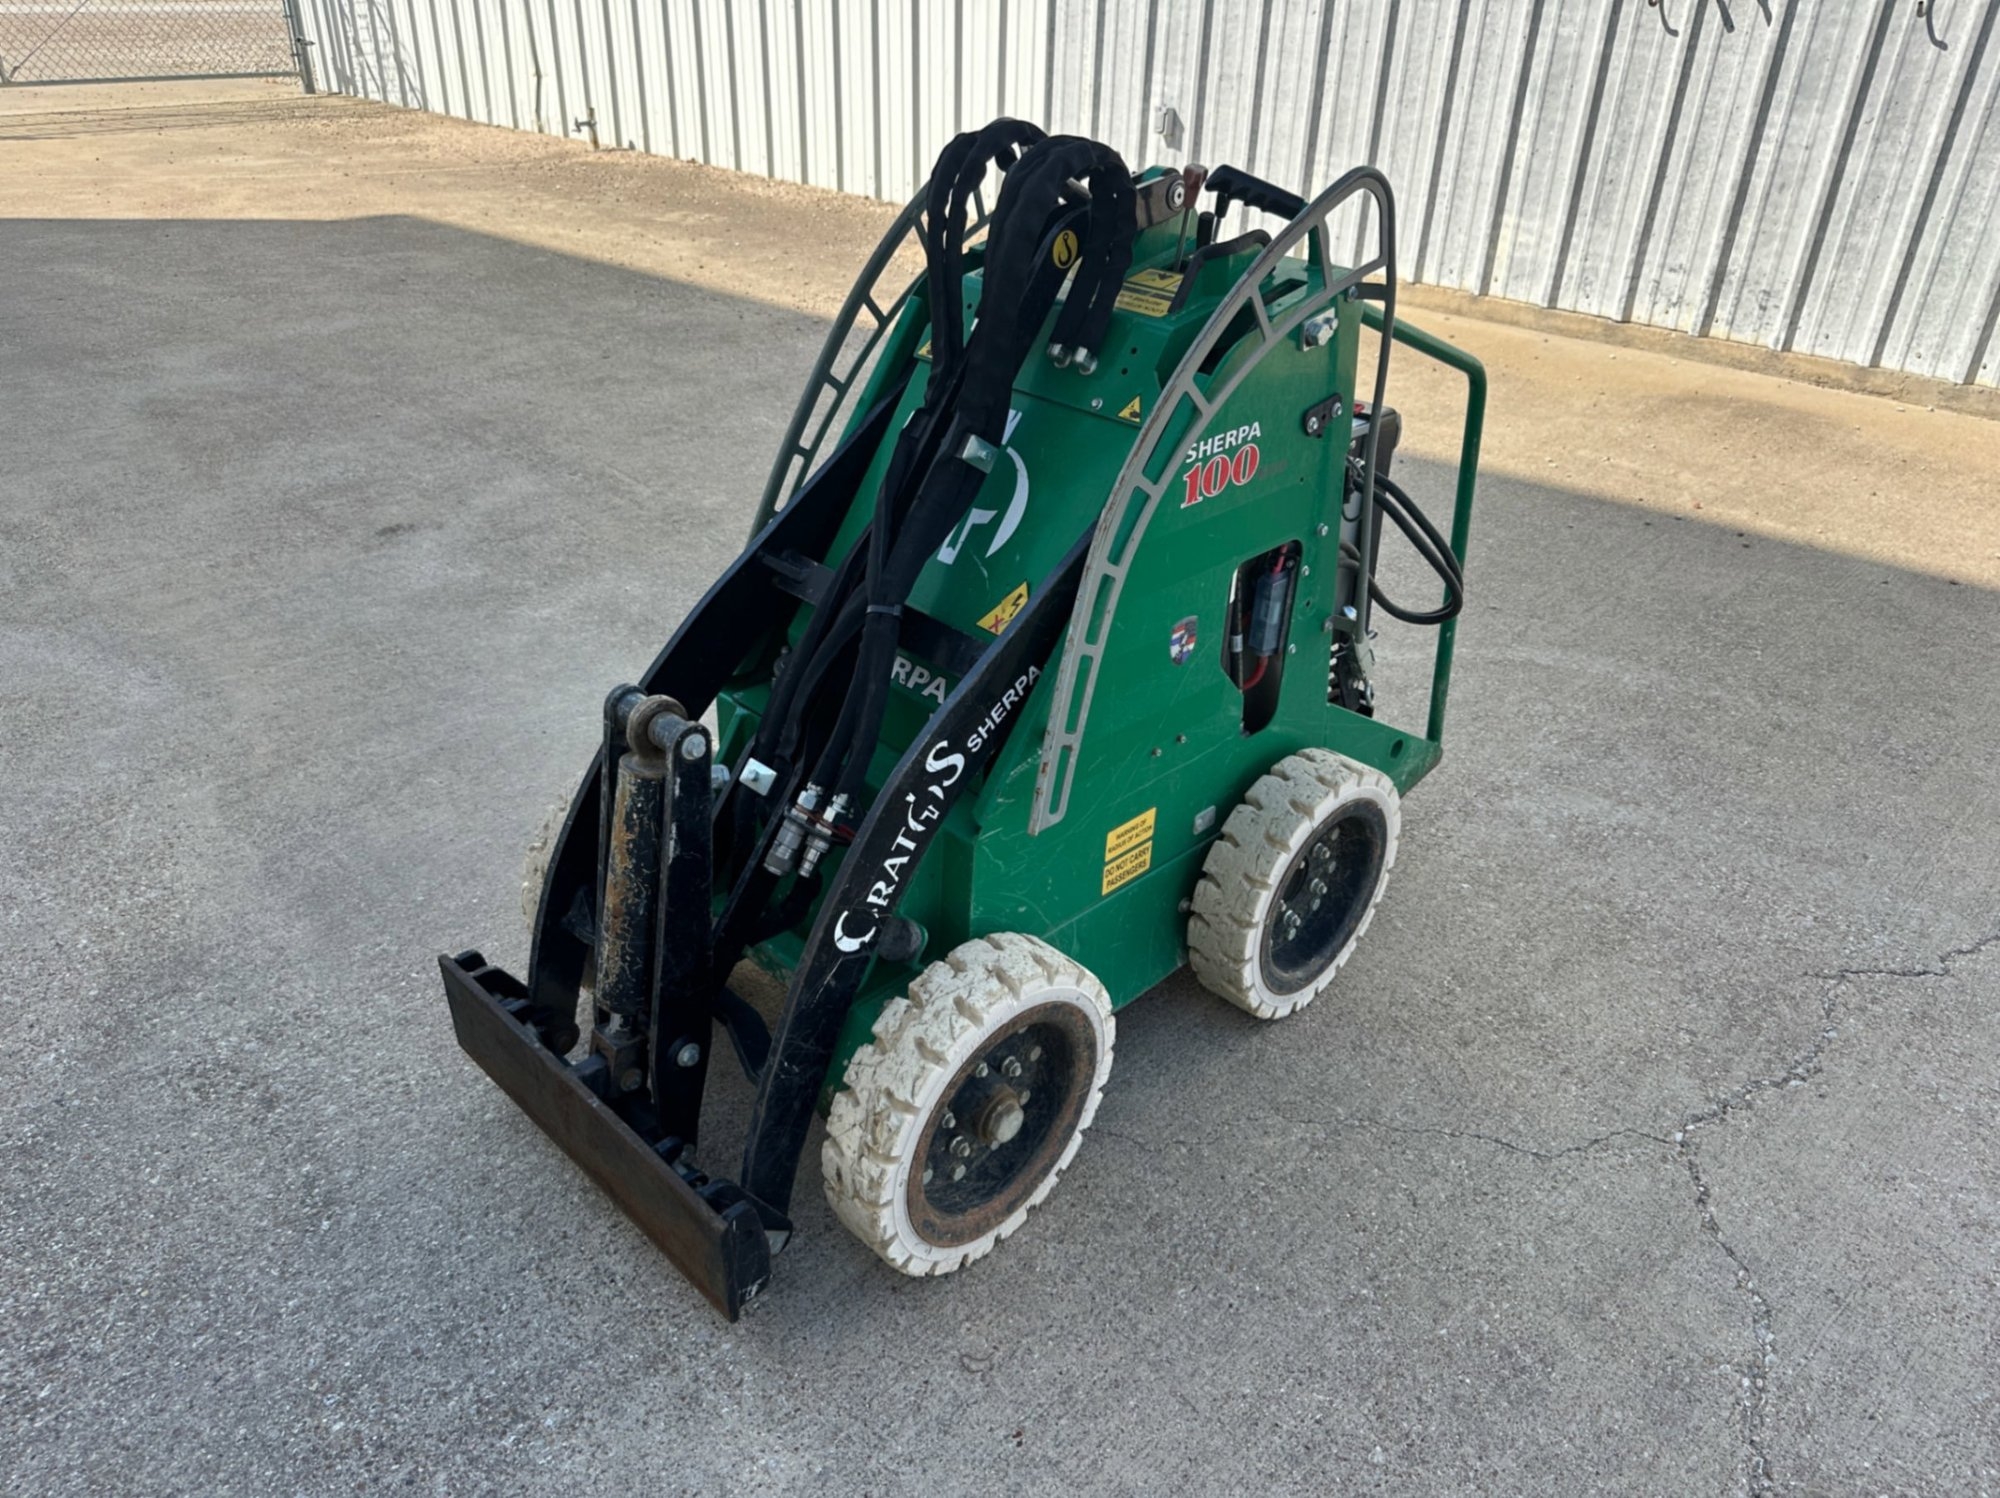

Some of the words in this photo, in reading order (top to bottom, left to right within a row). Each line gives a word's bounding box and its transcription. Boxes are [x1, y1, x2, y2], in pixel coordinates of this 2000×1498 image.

[1185, 421, 1261, 463] SHERPA
[1180, 443, 1260, 509] 100
[890, 655, 946, 704] RPA
[967, 665, 1041, 752] SHERPA
[1108, 838, 1126, 853] RADIUS
[1135, 825, 1152, 839] ACTION
[1116, 822, 1138, 840] WARNING
[1105, 866, 1115, 879] DO
[1116, 858, 1128, 871] NOT
[1129, 846, 1150, 863] CARRY
[1106, 858, 1147, 889] PASSENGERS
